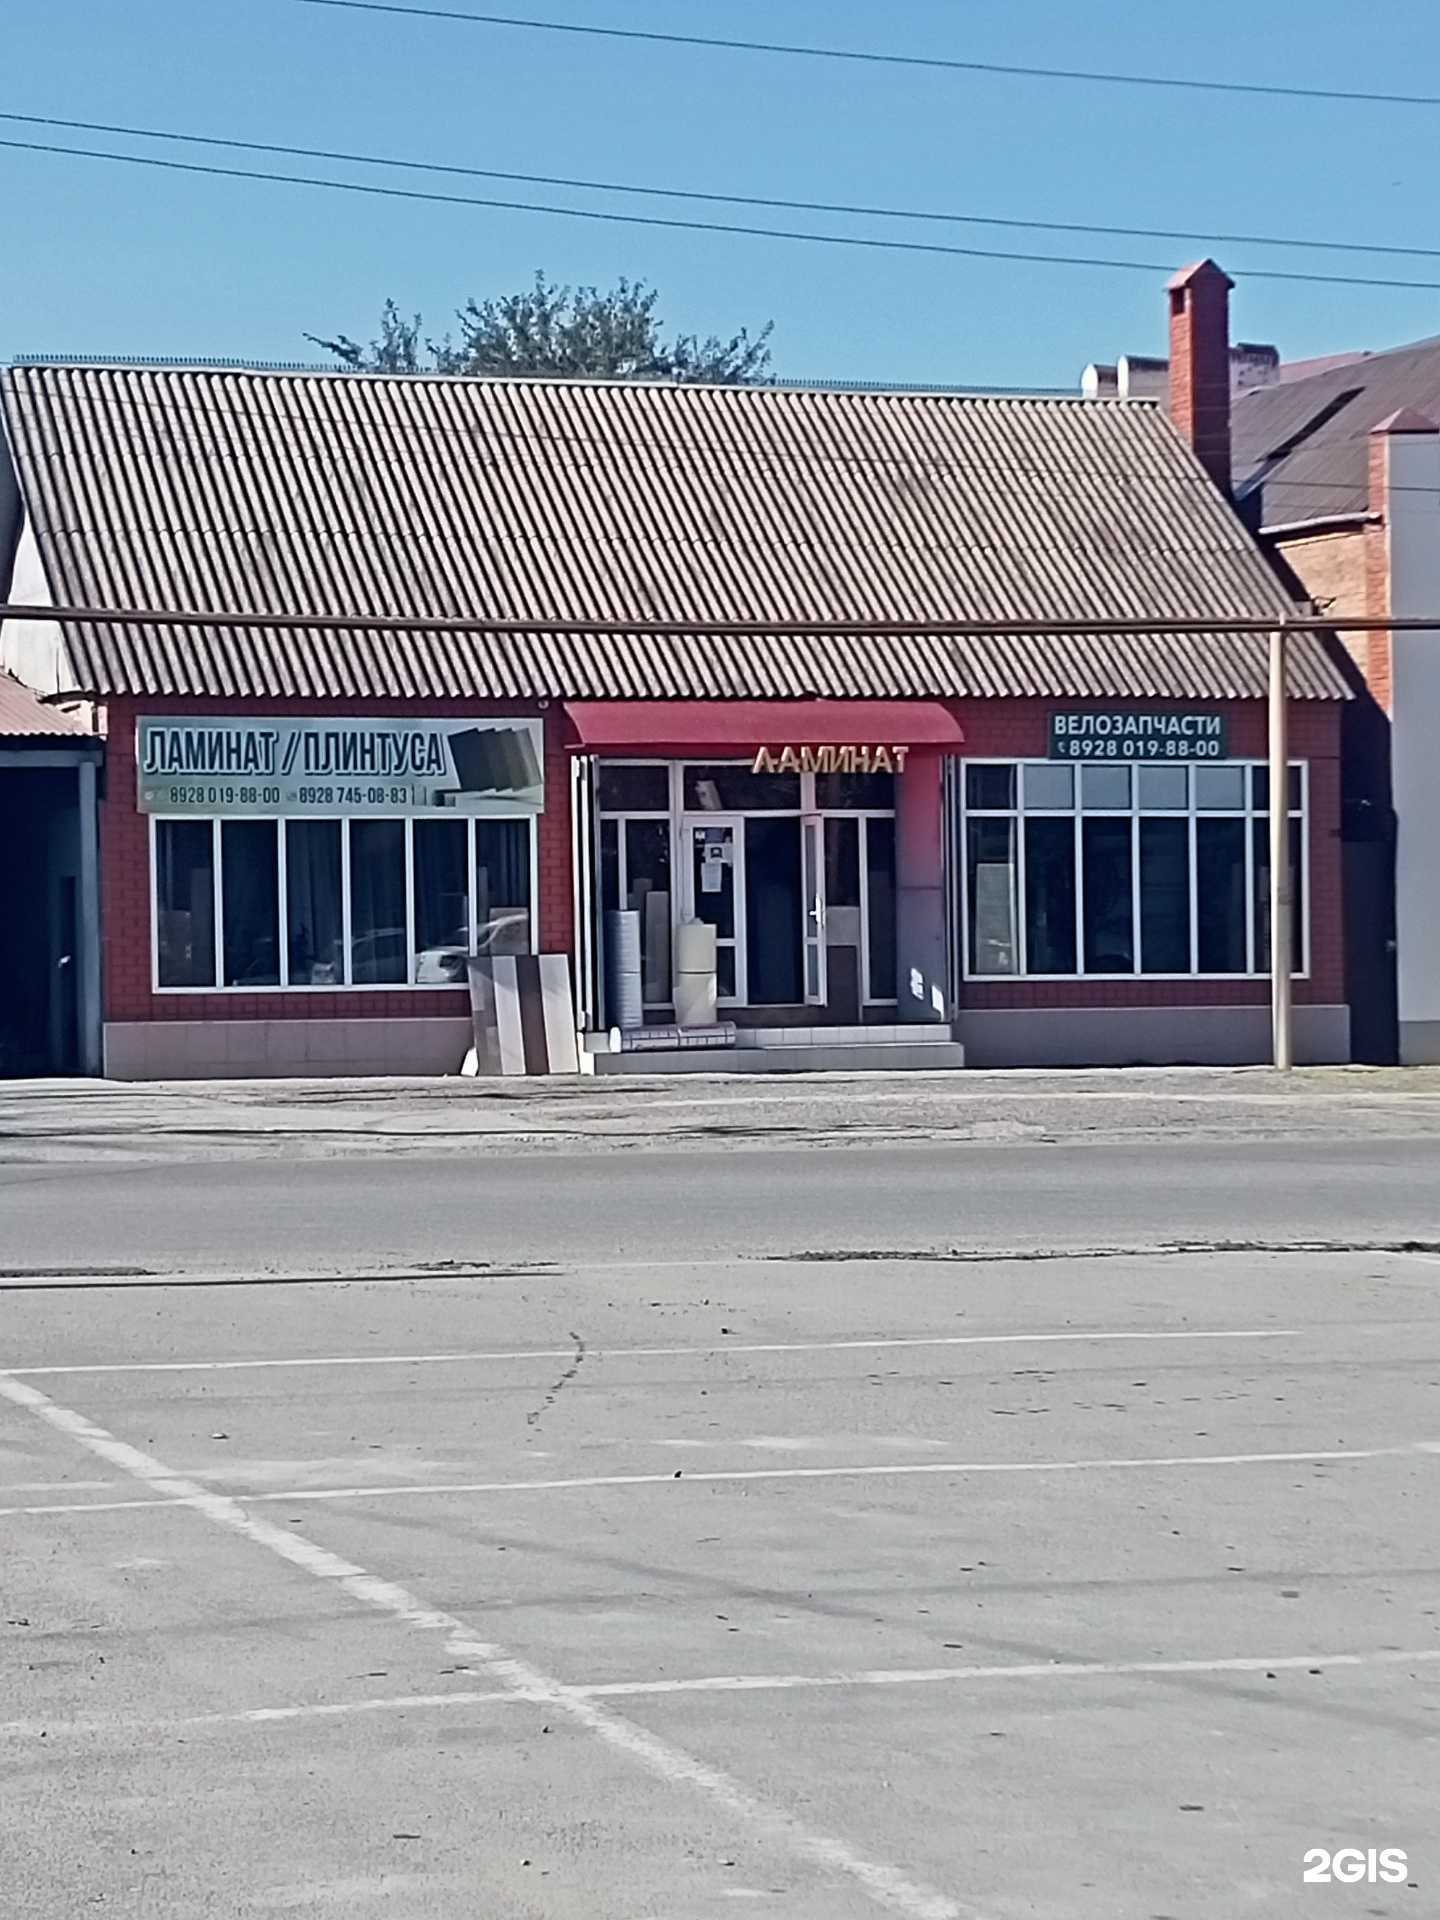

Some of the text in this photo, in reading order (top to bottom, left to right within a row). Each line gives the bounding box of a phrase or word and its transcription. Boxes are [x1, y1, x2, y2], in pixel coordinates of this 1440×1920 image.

[1054, 715, 1221, 735] ВЕЛОЗАПЧАСТИ
[144, 729, 278, 776] ЛАМИНАТ
[303, 730, 447, 776] ПЛИНТУСА
[1069, 740, 1219, 756] 8928 019-88-00
[752, 746, 909, 773] ЛАМИНАТ
[170, 787, 280, 804] 8928 019-88-00
[299, 787, 407, 804] 8928 745-08-83
